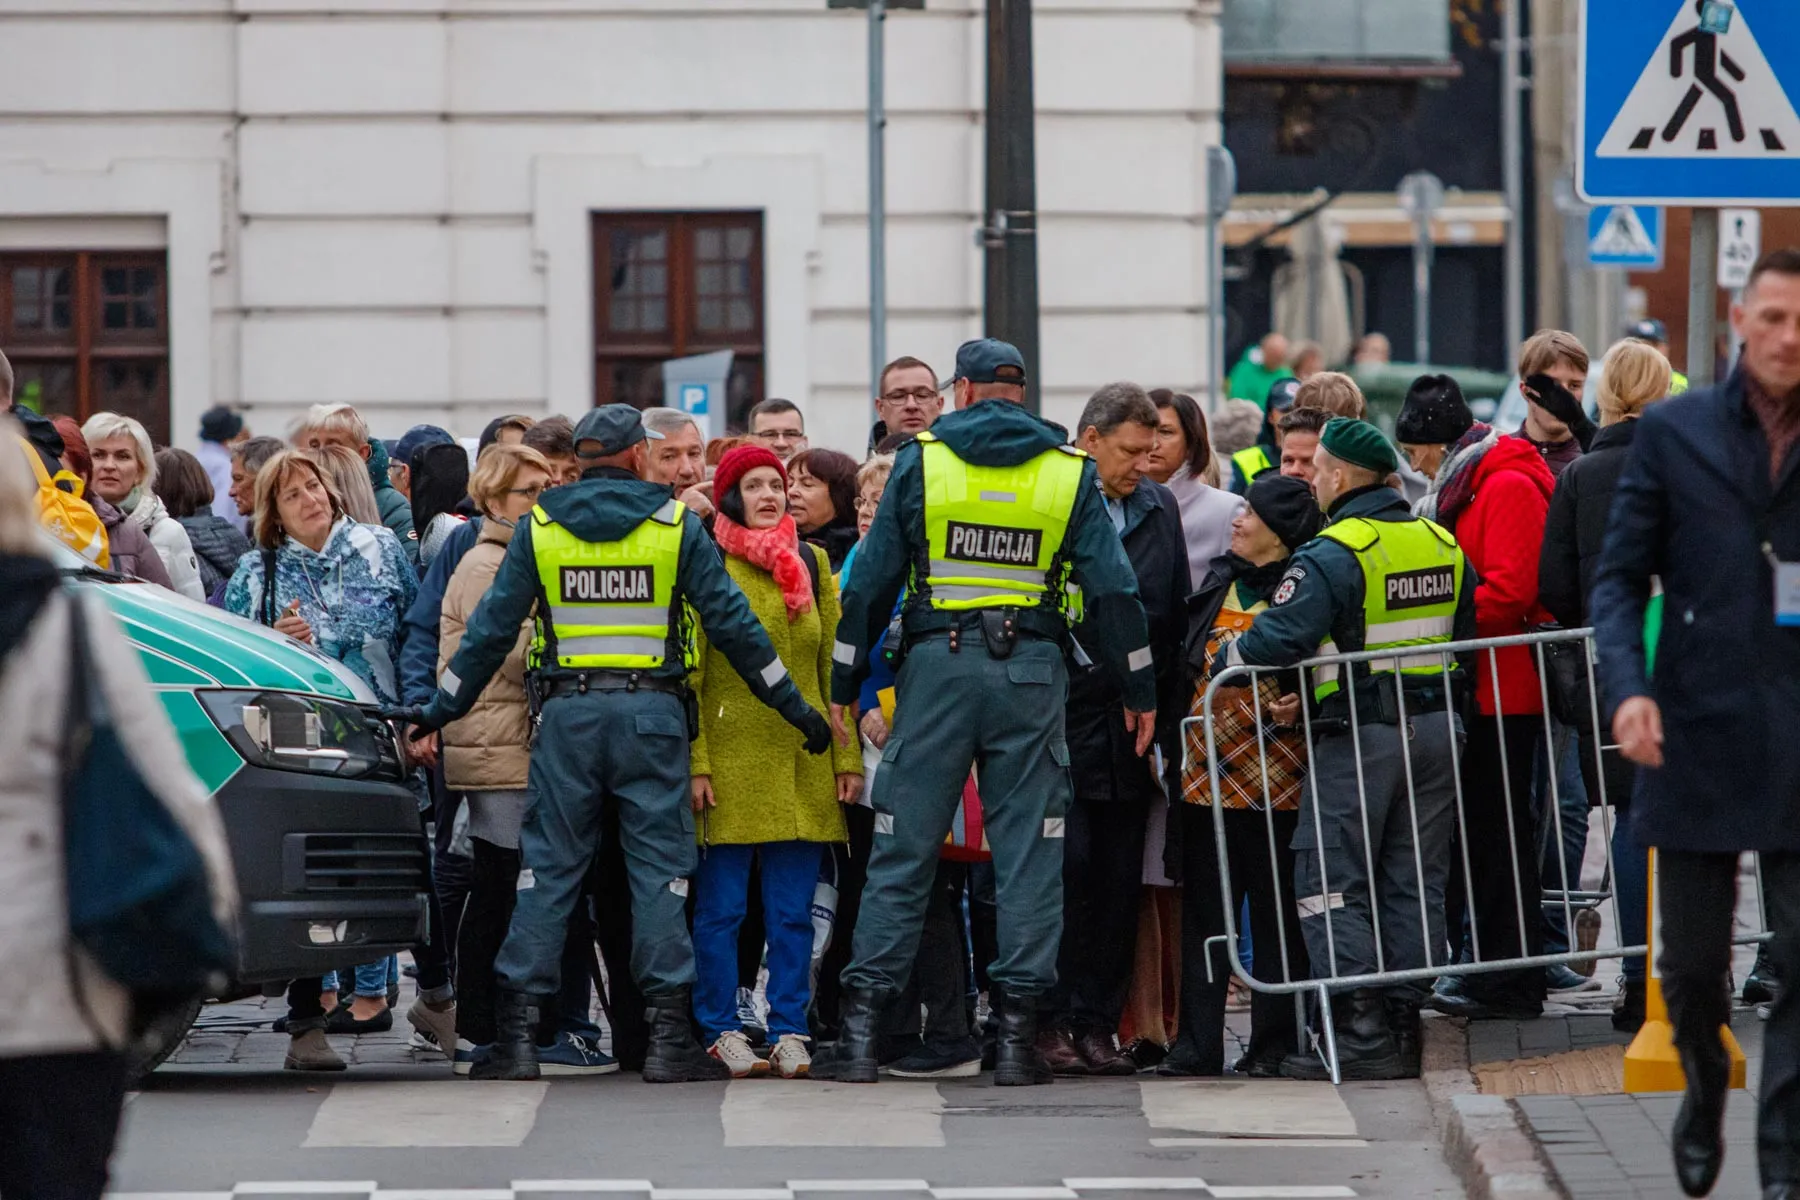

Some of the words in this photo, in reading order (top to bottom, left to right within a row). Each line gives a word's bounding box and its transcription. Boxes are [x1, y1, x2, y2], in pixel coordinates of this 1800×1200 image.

[685, 388, 704, 411] P
[951, 526, 1034, 562] POLICIJA
[565, 570, 649, 599] POLICIJA
[1387, 573, 1453, 600] POLICIJA
